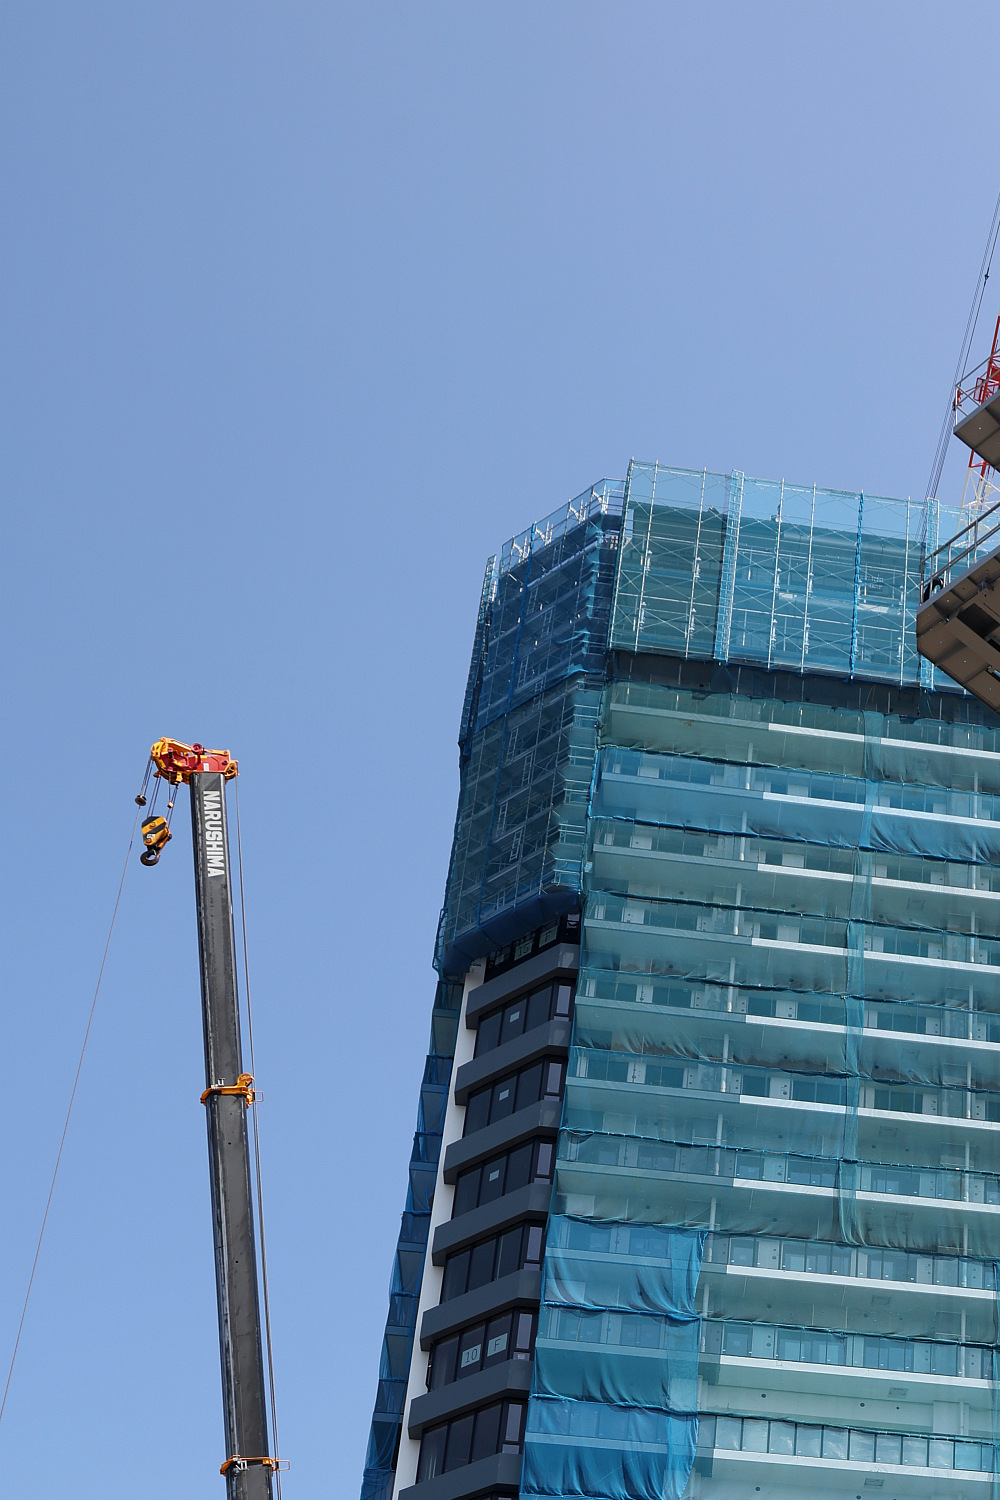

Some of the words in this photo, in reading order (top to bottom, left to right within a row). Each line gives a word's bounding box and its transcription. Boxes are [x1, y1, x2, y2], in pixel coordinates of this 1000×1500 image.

[203, 790, 225, 877] NARUSHIMA
[465, 1348, 478, 1363] 10
[494, 1338, 502, 1351] F
